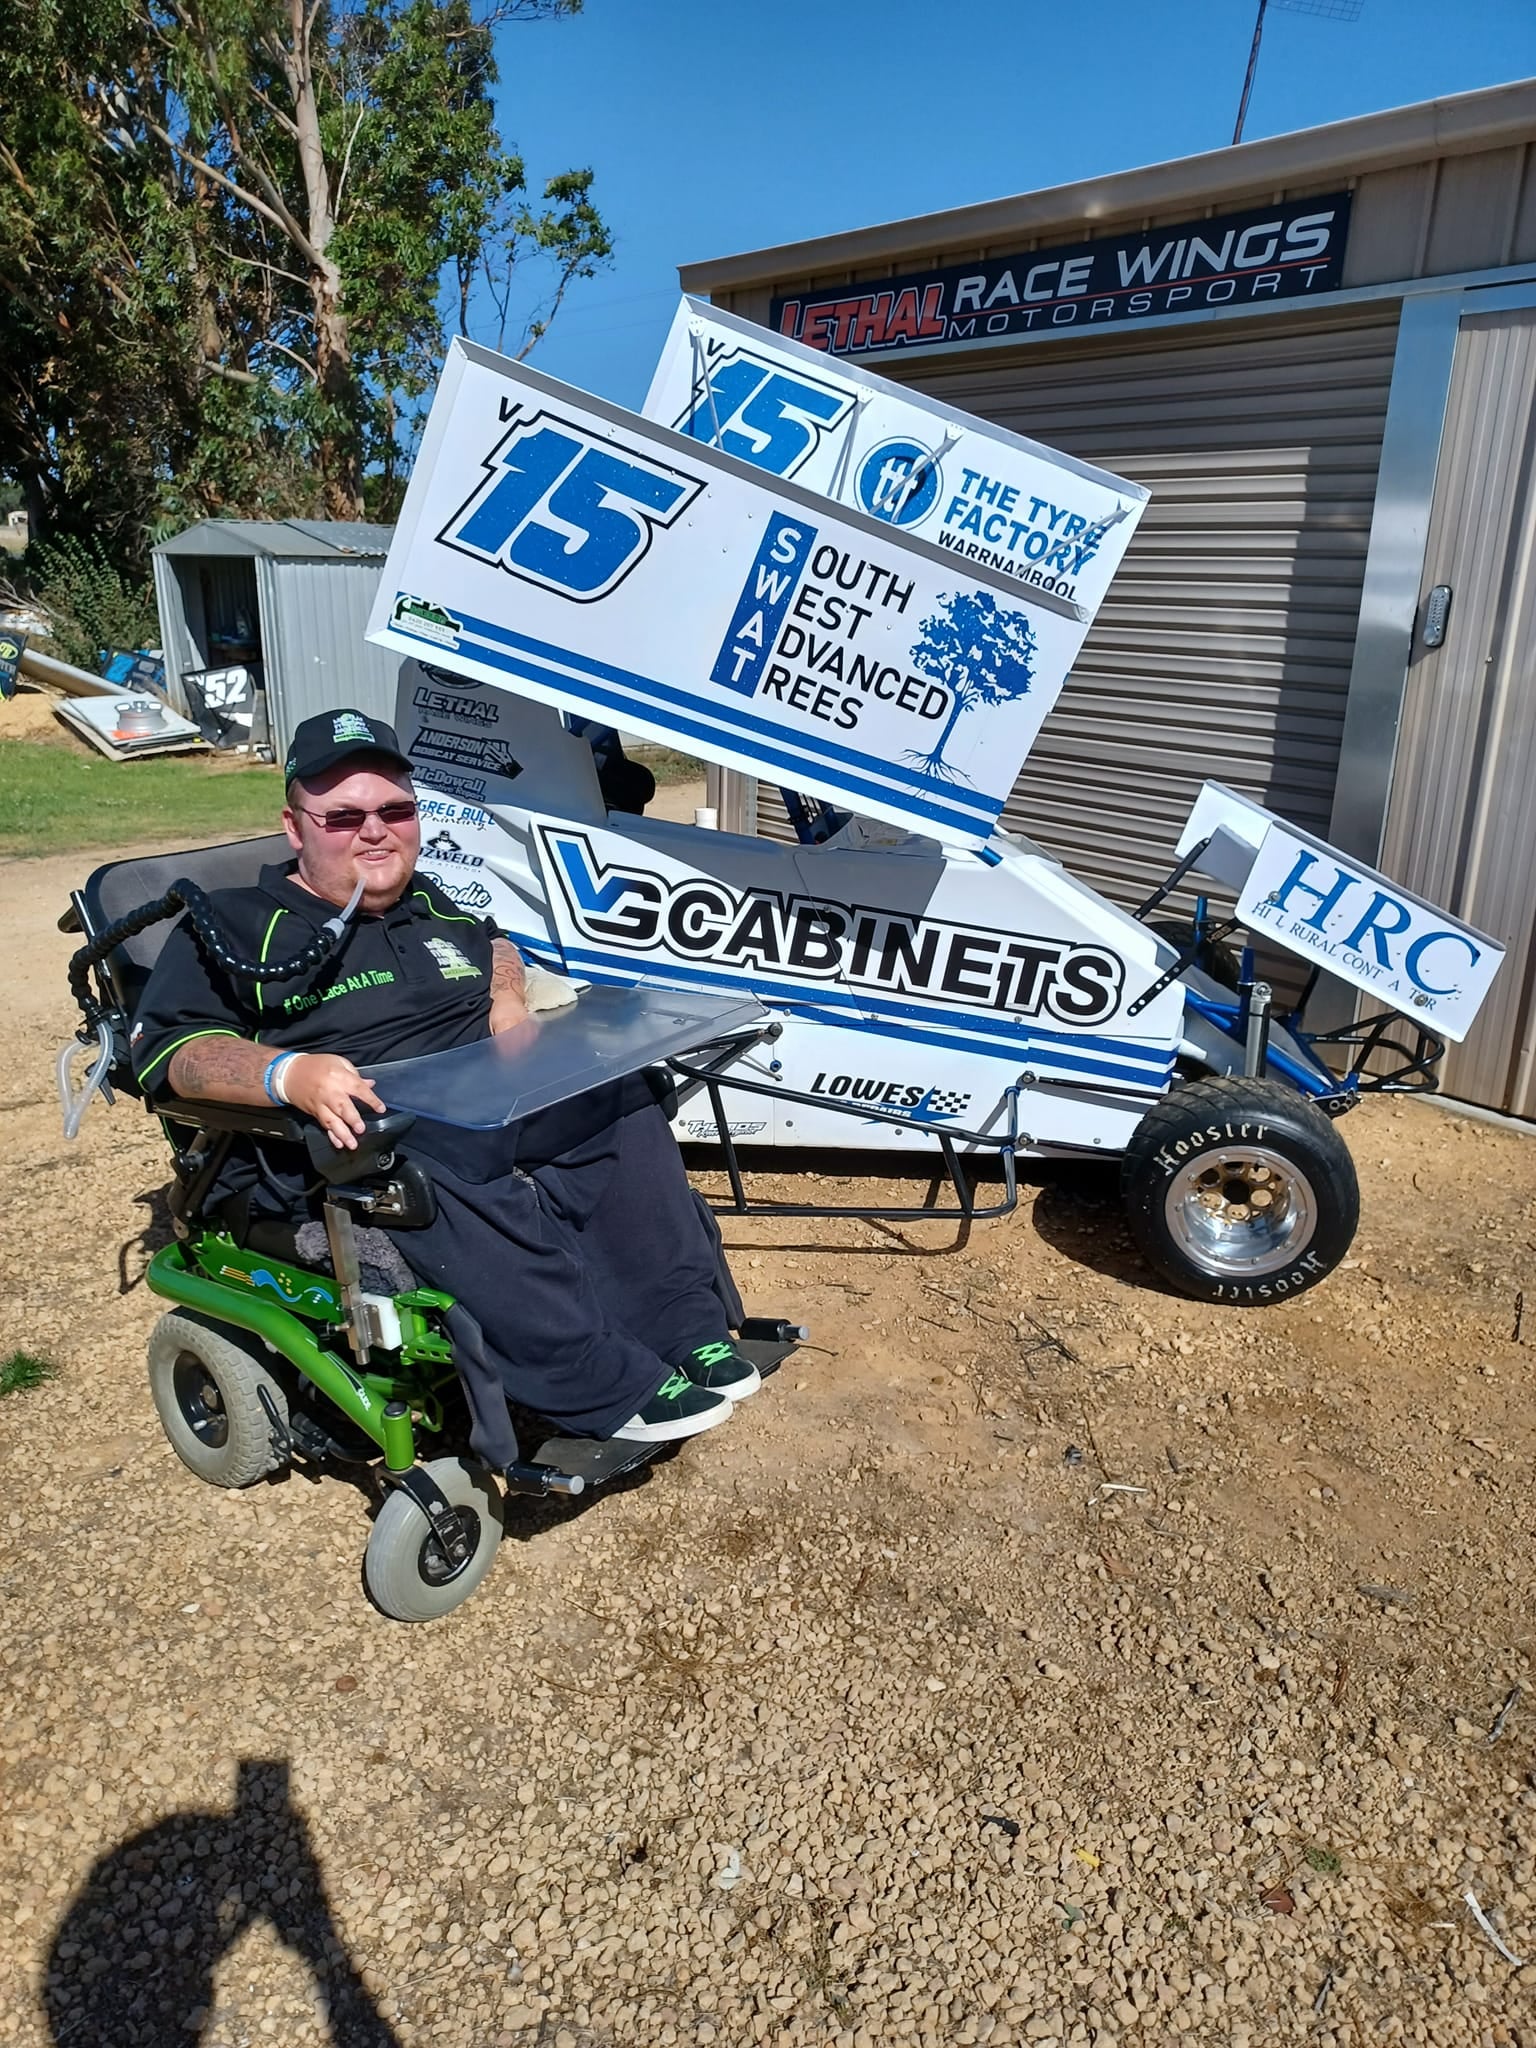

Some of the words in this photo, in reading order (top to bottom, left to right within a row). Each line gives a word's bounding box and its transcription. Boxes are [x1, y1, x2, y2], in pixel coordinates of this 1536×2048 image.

[779, 283, 949, 353] LETHAL
[953, 256, 1094, 313] RACE
[1118, 211, 1336, 288] WINGS
[948, 265, 1328, 339] MOTORSPORT
[707, 337, 726, 357] V
[498, 396, 524, 423] V
[675, 353, 850, 477] 15
[445, 417, 698, 598] 15
[961, 467, 1021, 514] THE
[1029, 495, 1108, 550] TYRE
[944, 495, 1097, 577] FACTORY
[938, 530, 1078, 602] WARRNAMBOOL
[205, 669, 248, 709] 52
[413, 686, 500, 723] LETHAL
[418, 729, 486, 756] ANDERSON
[412, 765, 486, 795] McDowall
[455, 753, 502, 772] SERVICE
[418, 799, 457, 817] GREG
[1265, 849, 1482, 995] HRC
[1289, 922, 1337, 957] RURAL
[665, 885, 1118, 1021] CABINETS
[317, 983, 348, 1001] Lace
[346, 975, 362, 991] At
[360, 971, 372, 987] A
[368, 970, 395, 985] Time
[810, 1073, 925, 1107] LOWES
